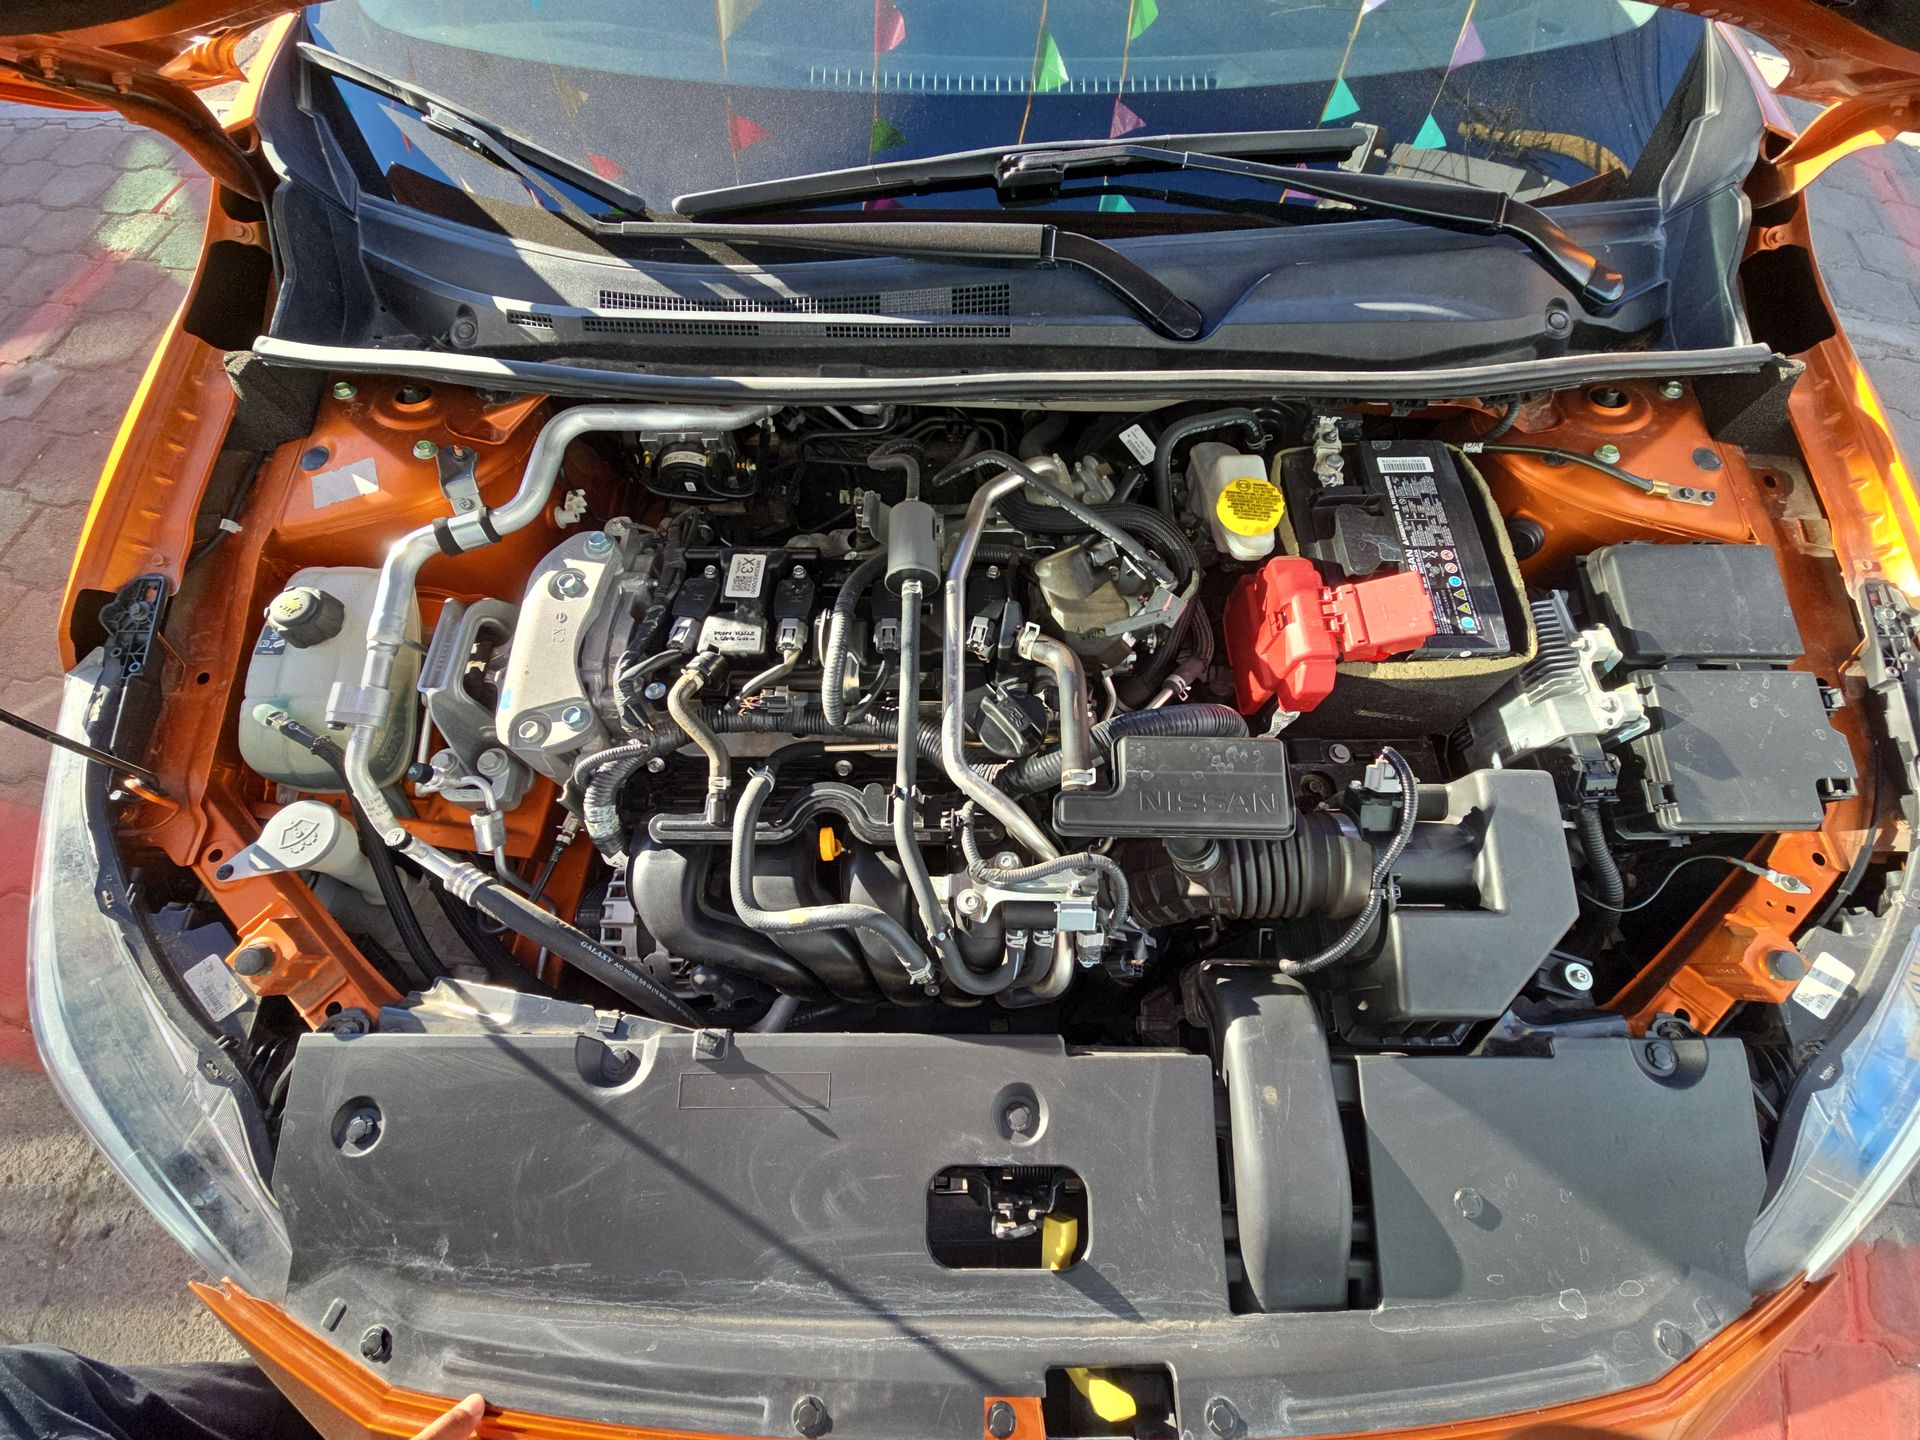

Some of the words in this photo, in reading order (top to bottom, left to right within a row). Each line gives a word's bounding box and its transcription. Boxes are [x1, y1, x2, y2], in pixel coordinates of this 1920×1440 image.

[741, 558, 756, 574] X3
[1405, 549, 1418, 572] SAN
[1139, 790, 1280, 814] NISSAN
[580, 941, 613, 962] GALAXY
[614, 962, 623, 971] A/C
[623, 968, 639, 981] HOSE
